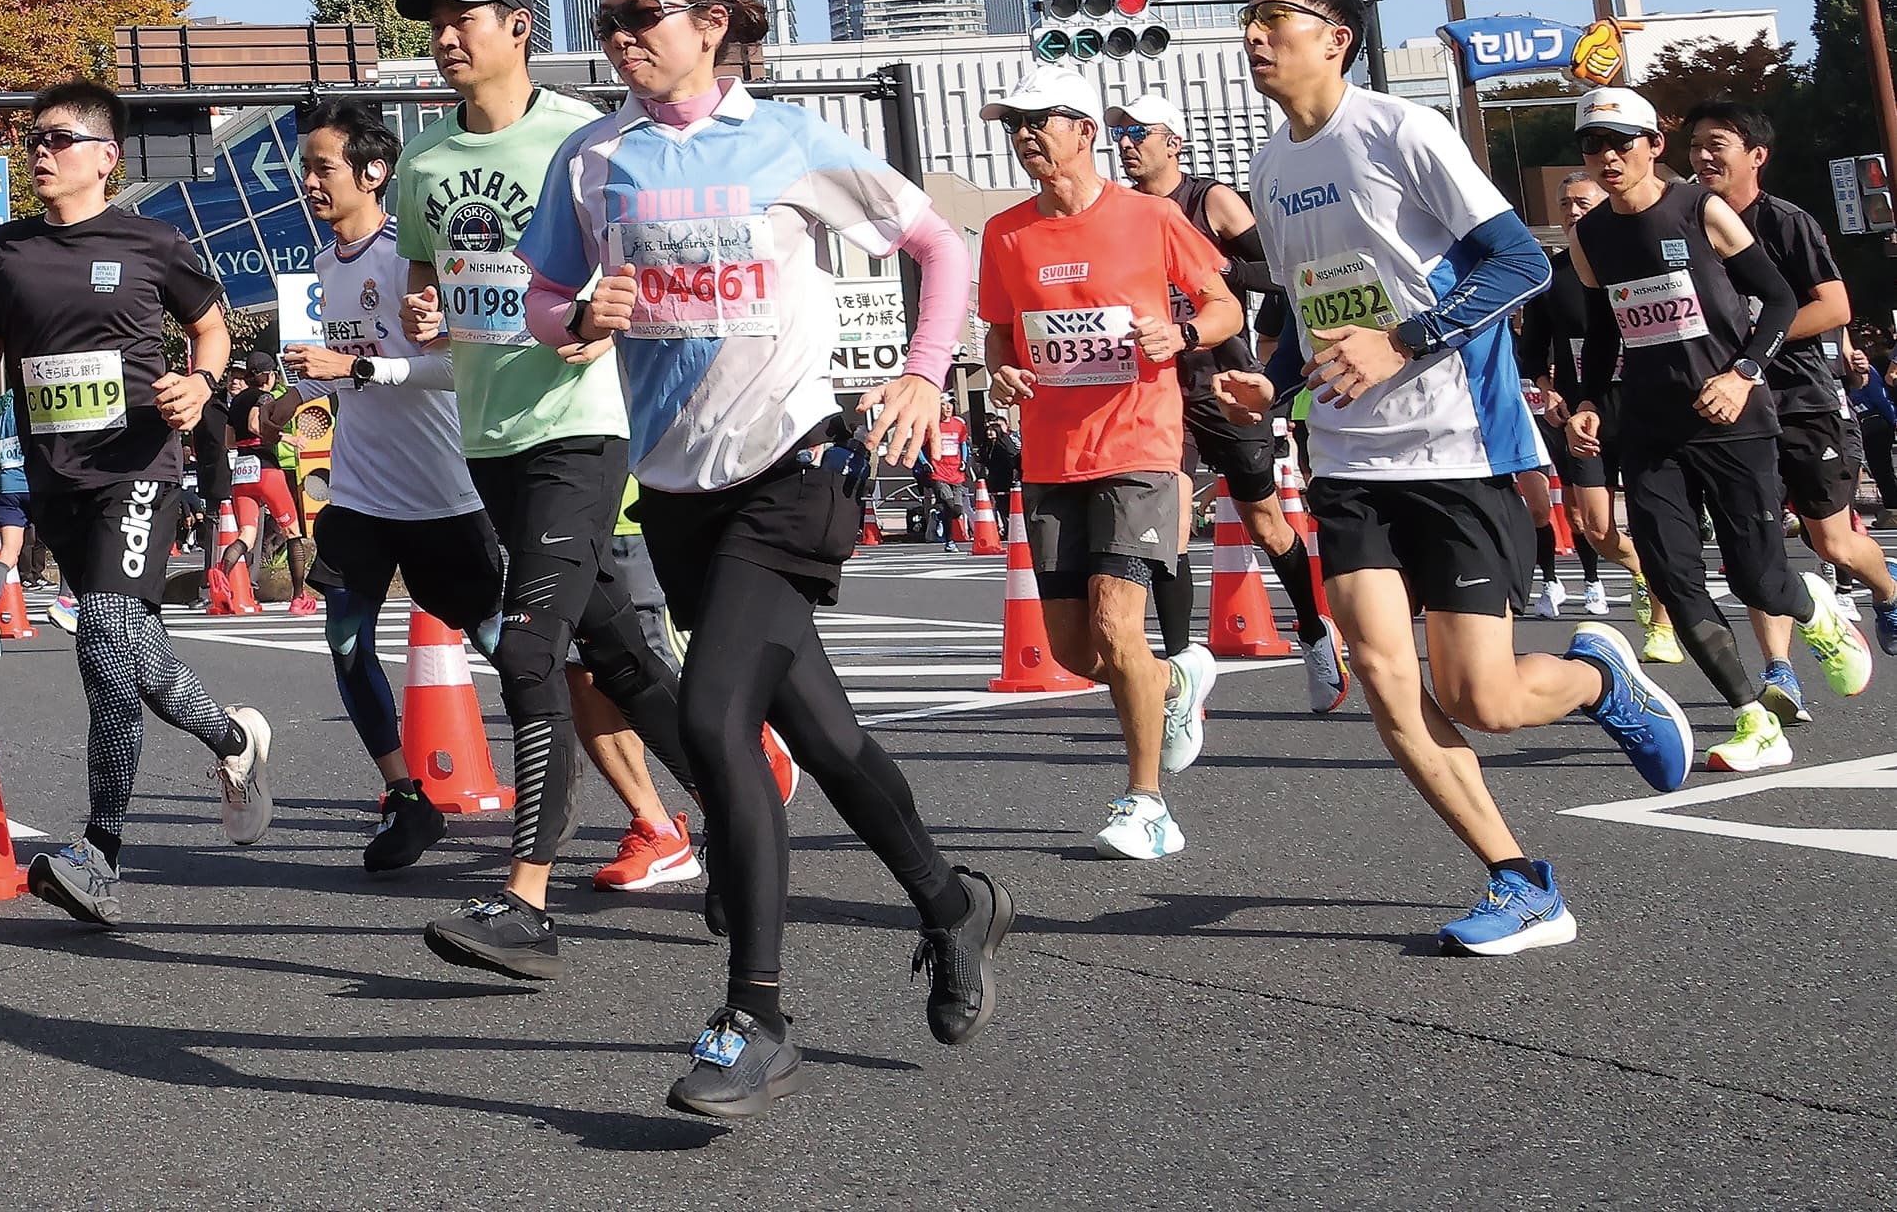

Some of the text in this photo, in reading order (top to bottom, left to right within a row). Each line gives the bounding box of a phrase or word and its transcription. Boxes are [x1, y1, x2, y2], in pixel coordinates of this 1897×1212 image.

[1468, 28, 1565, 64] セルフ
[425, 168, 535, 234] MINATO
[1278, 183, 1341, 217] YASDA
[457, 207, 493, 222] TOKYO
[272, 245, 320, 272] H2
[1042, 264, 1085, 279] SVOLME
[1315, 260, 1364, 281] NISHIMATSU
[640, 263, 766, 305] 04661
[1633, 280, 1683, 296] NISHIMATSU
[453, 286, 519, 317] 0198
[835, 293, 897, 308] を弾いて
[1170, 299, 1195, 317] 73
[1313, 285, 1389, 326] 05232
[1627, 297, 1698, 328] 03022
[327, 320, 365, 340] 長谷工
[1031, 338, 1132, 364] B 03335
[45, 363, 101, 379] きらぼし銀行
[28, 381, 120, 412] C 05119
